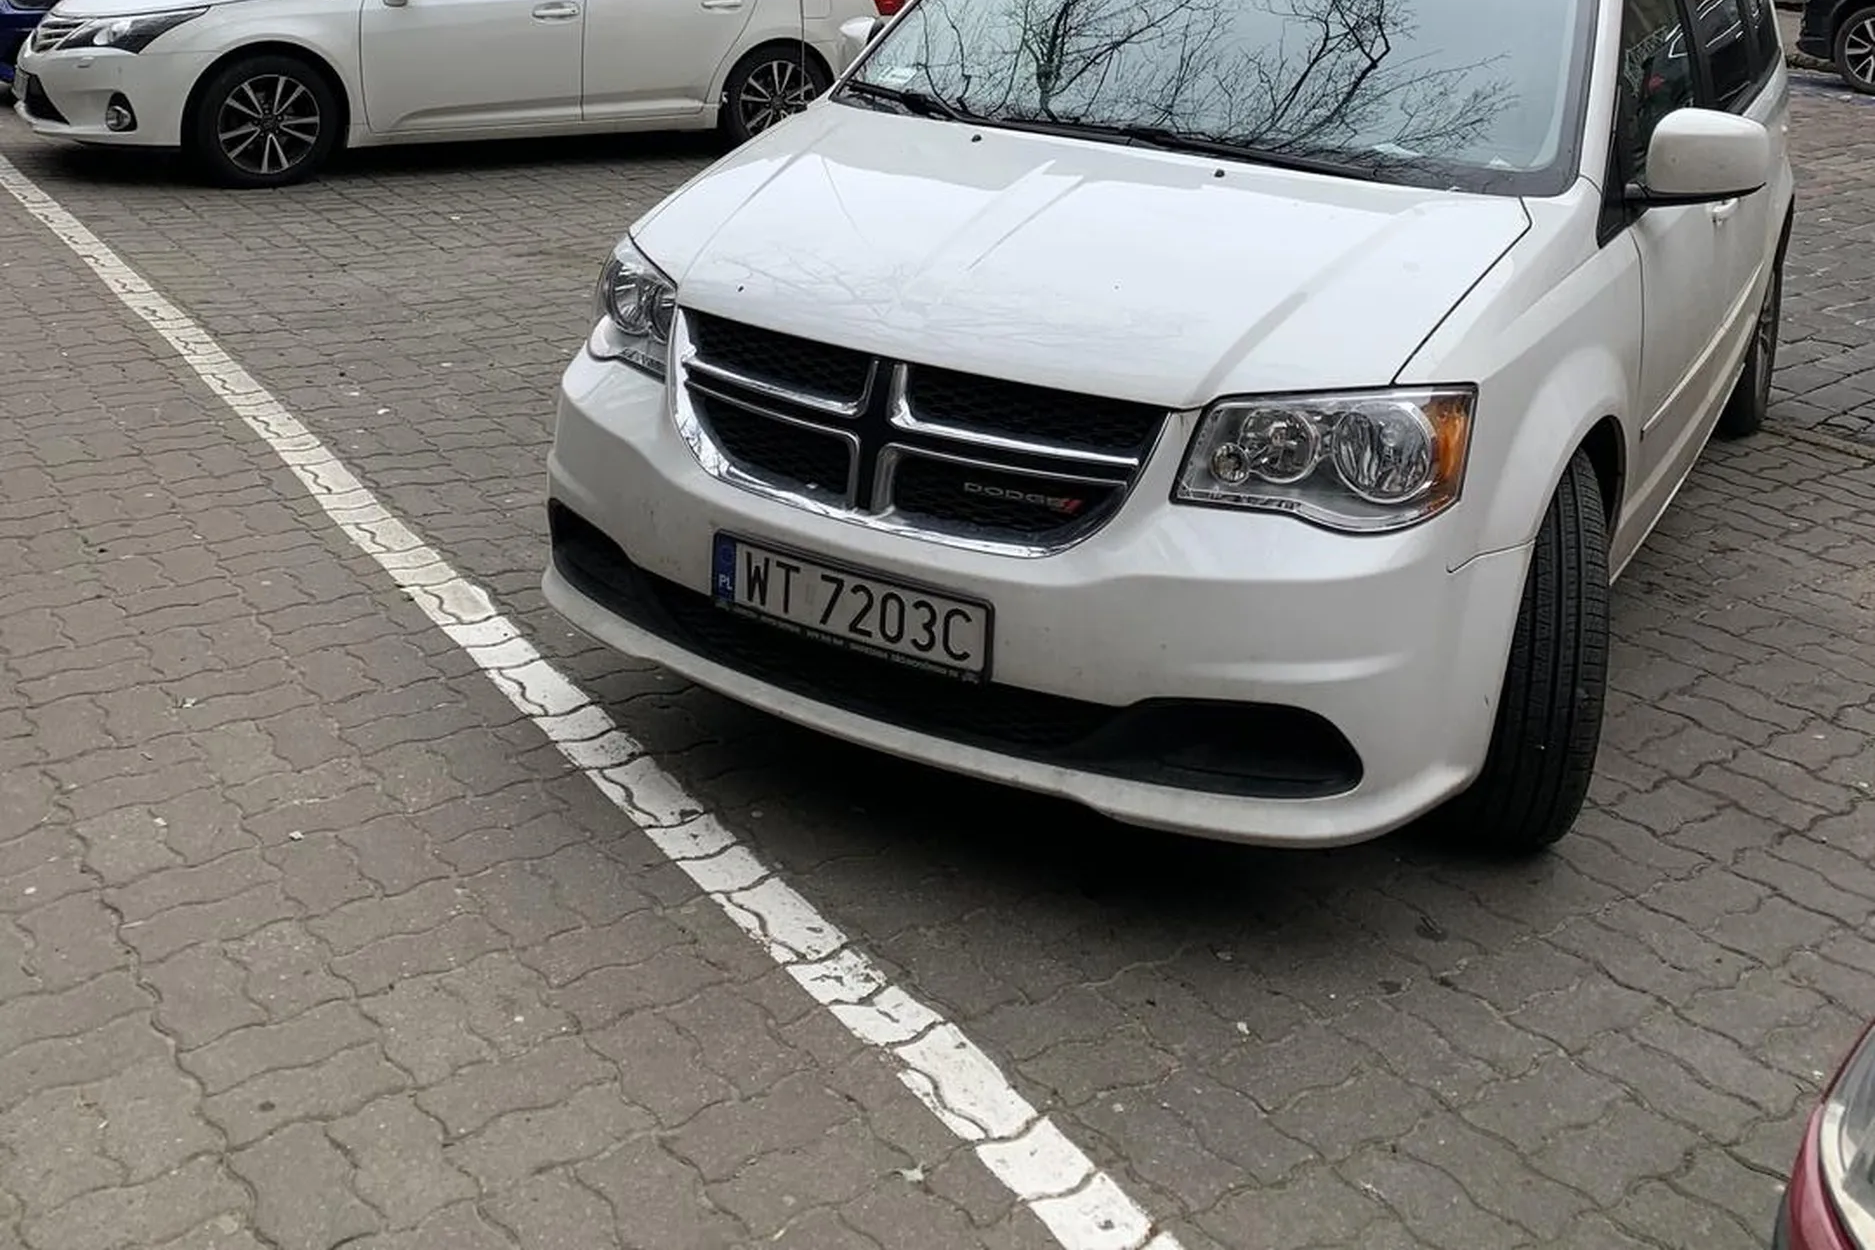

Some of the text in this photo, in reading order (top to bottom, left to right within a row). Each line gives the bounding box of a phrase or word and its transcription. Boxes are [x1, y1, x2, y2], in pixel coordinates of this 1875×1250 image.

[964, 482, 1069, 510] DODGE
[719, 573, 732, 591] PL
[745, 551, 973, 661] WT 7203C
